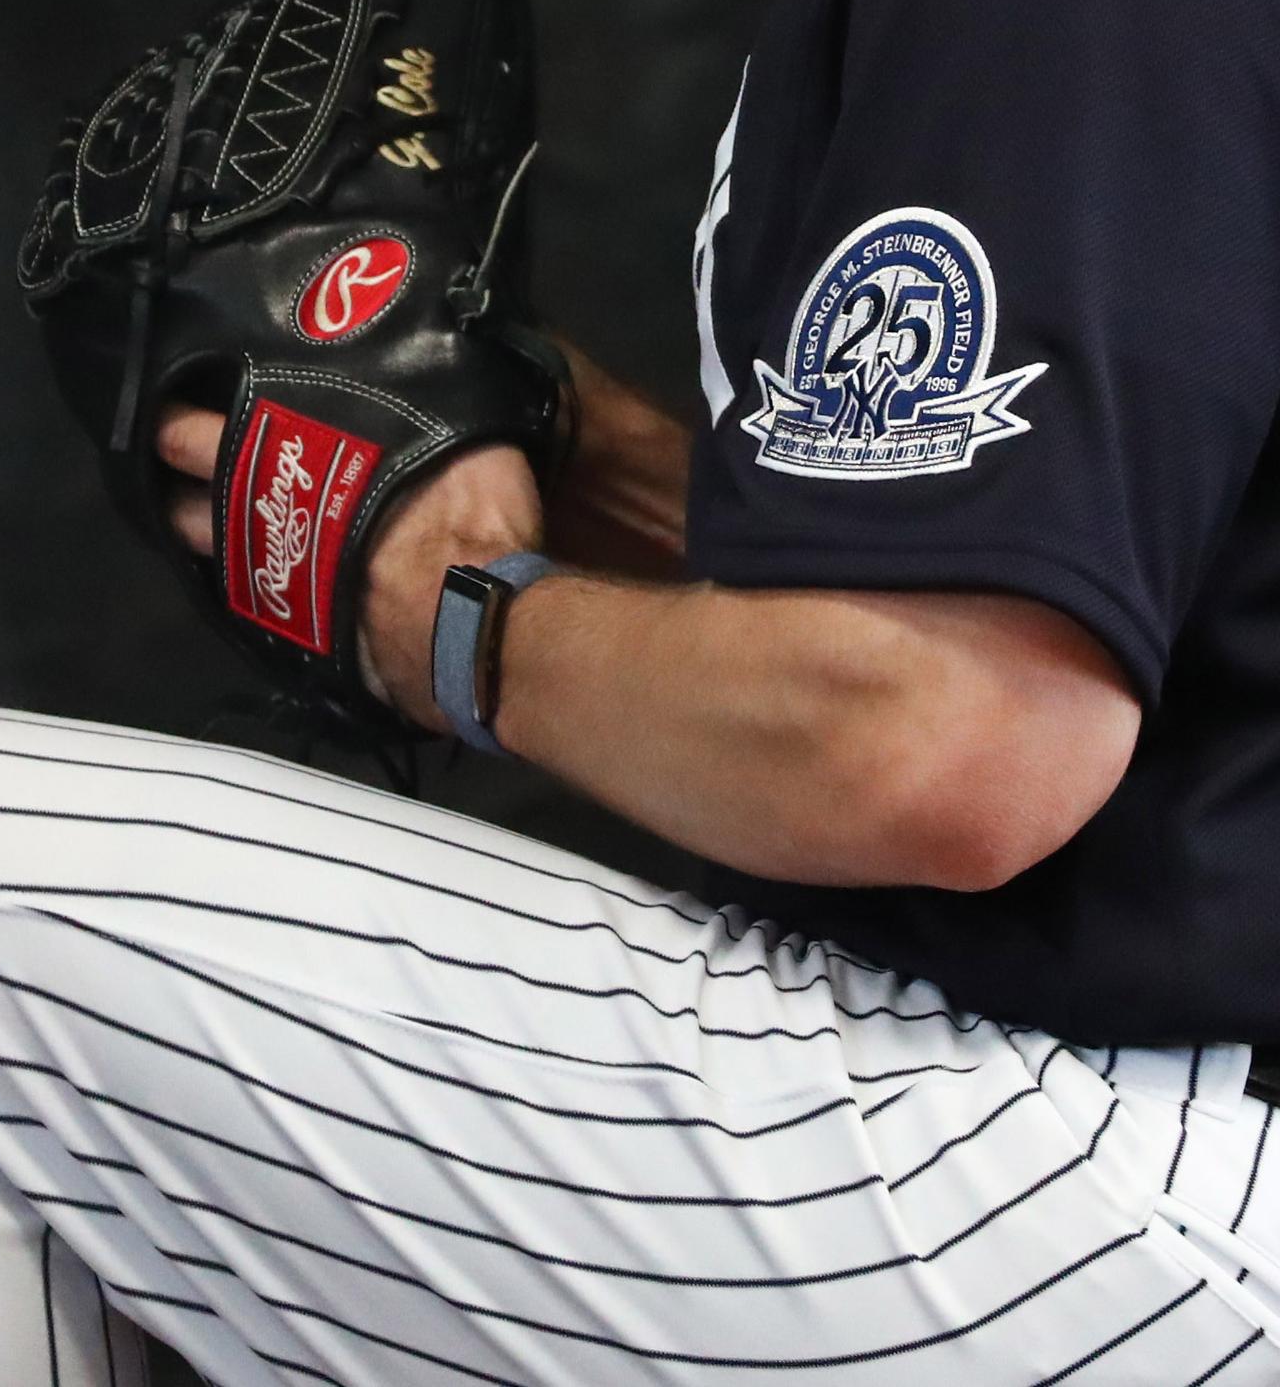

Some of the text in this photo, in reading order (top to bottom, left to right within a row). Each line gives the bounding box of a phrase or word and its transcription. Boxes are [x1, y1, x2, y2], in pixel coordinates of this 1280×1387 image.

[375, 47, 439, 117] Cole
[313, 246, 403, 334] R
[802, 232, 973, 374] GEORGE M. STEINBRENNER FIELD
[822, 281, 943, 378] 25
[798, 373, 959, 393] EST 1996
[254, 434, 313, 621] Rawlings
[325, 450, 366, 521] Est. 1887
